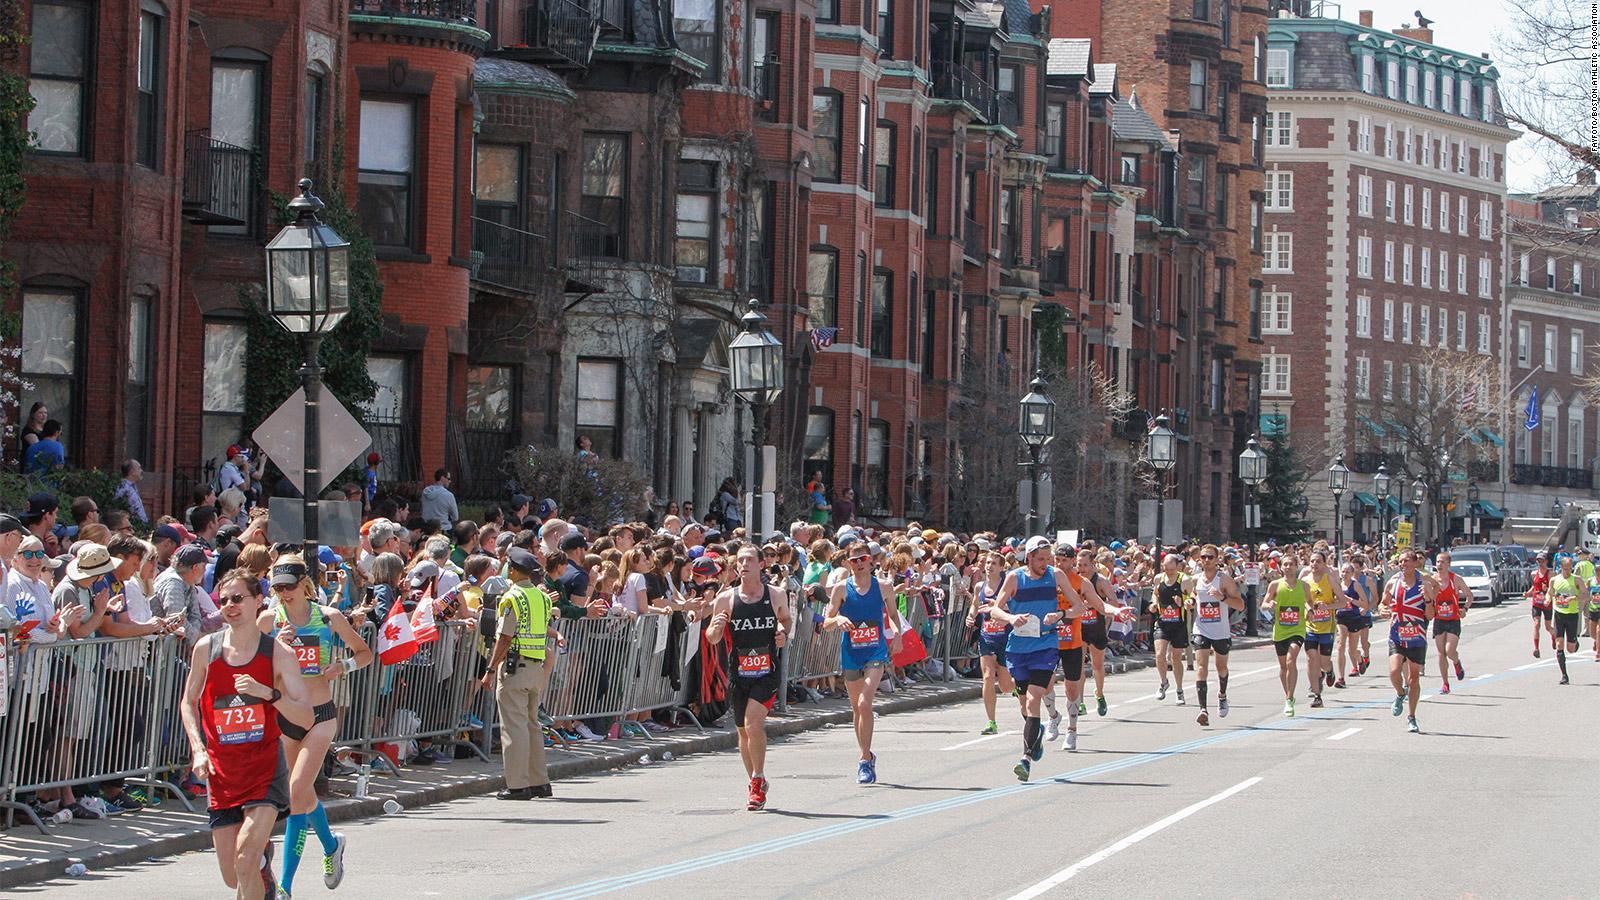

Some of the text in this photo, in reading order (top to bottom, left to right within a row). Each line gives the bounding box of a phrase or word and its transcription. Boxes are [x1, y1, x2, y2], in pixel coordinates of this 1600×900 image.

[519, 594, 529, 629] BOSTON
[1201, 607, 1219, 615] 1555
[731, 616, 775, 631] YALE
[853, 627, 876, 639] 2245
[743, 656, 767, 667] 4302
[223, 707, 256, 726] 732
